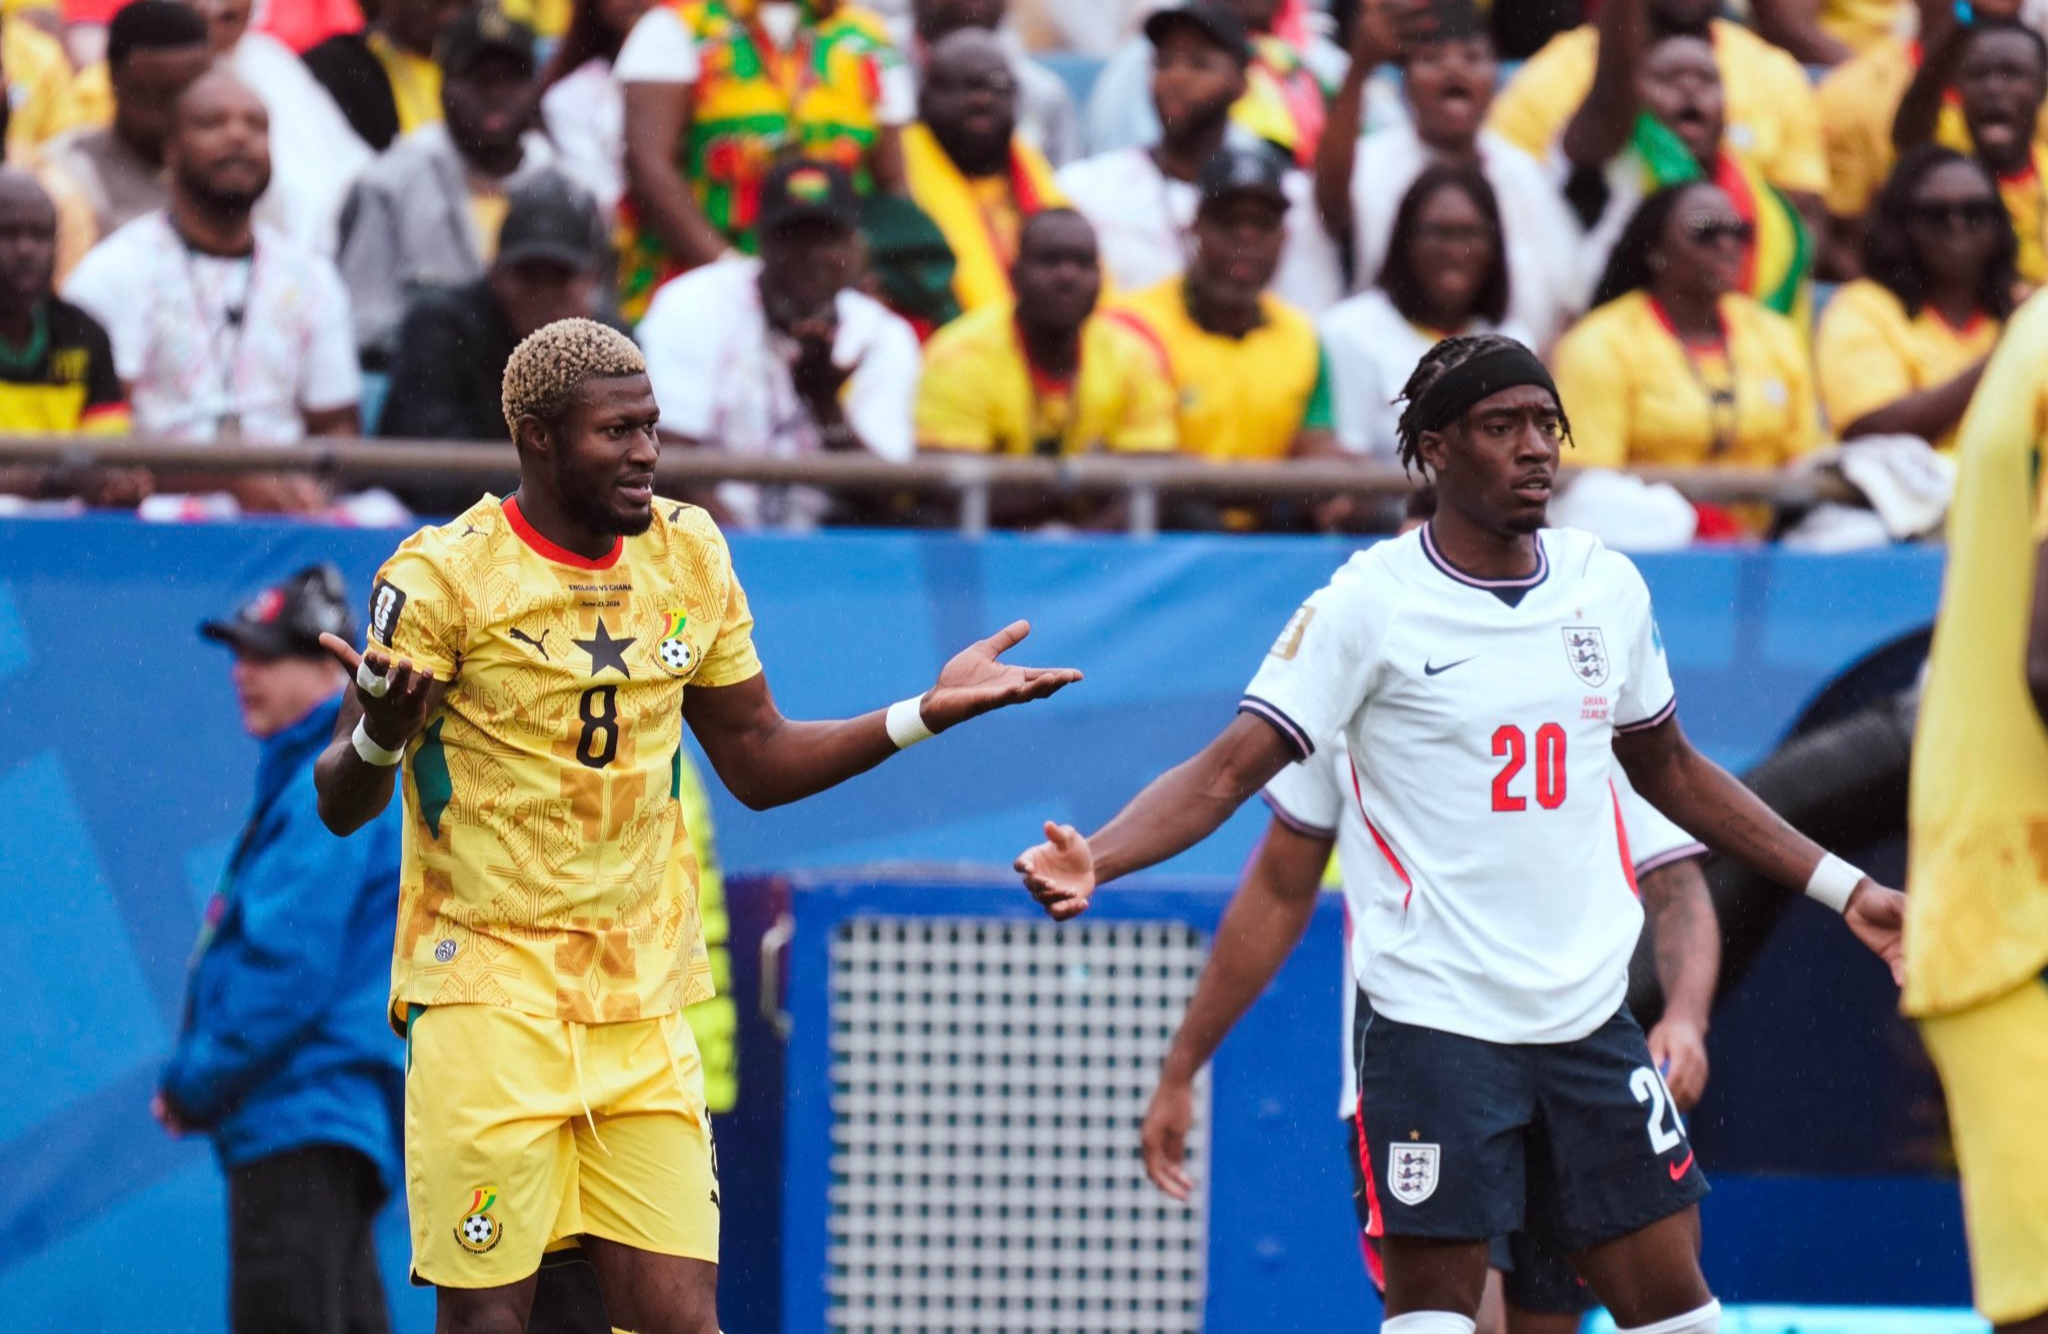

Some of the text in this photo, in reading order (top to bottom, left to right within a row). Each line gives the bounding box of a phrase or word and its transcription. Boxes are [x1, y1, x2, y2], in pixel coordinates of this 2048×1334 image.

[568, 583, 633, 592] ENGLAND VS GHANA
[576, 684, 617, 768] 8
[1491, 723, 1567, 812] 20
